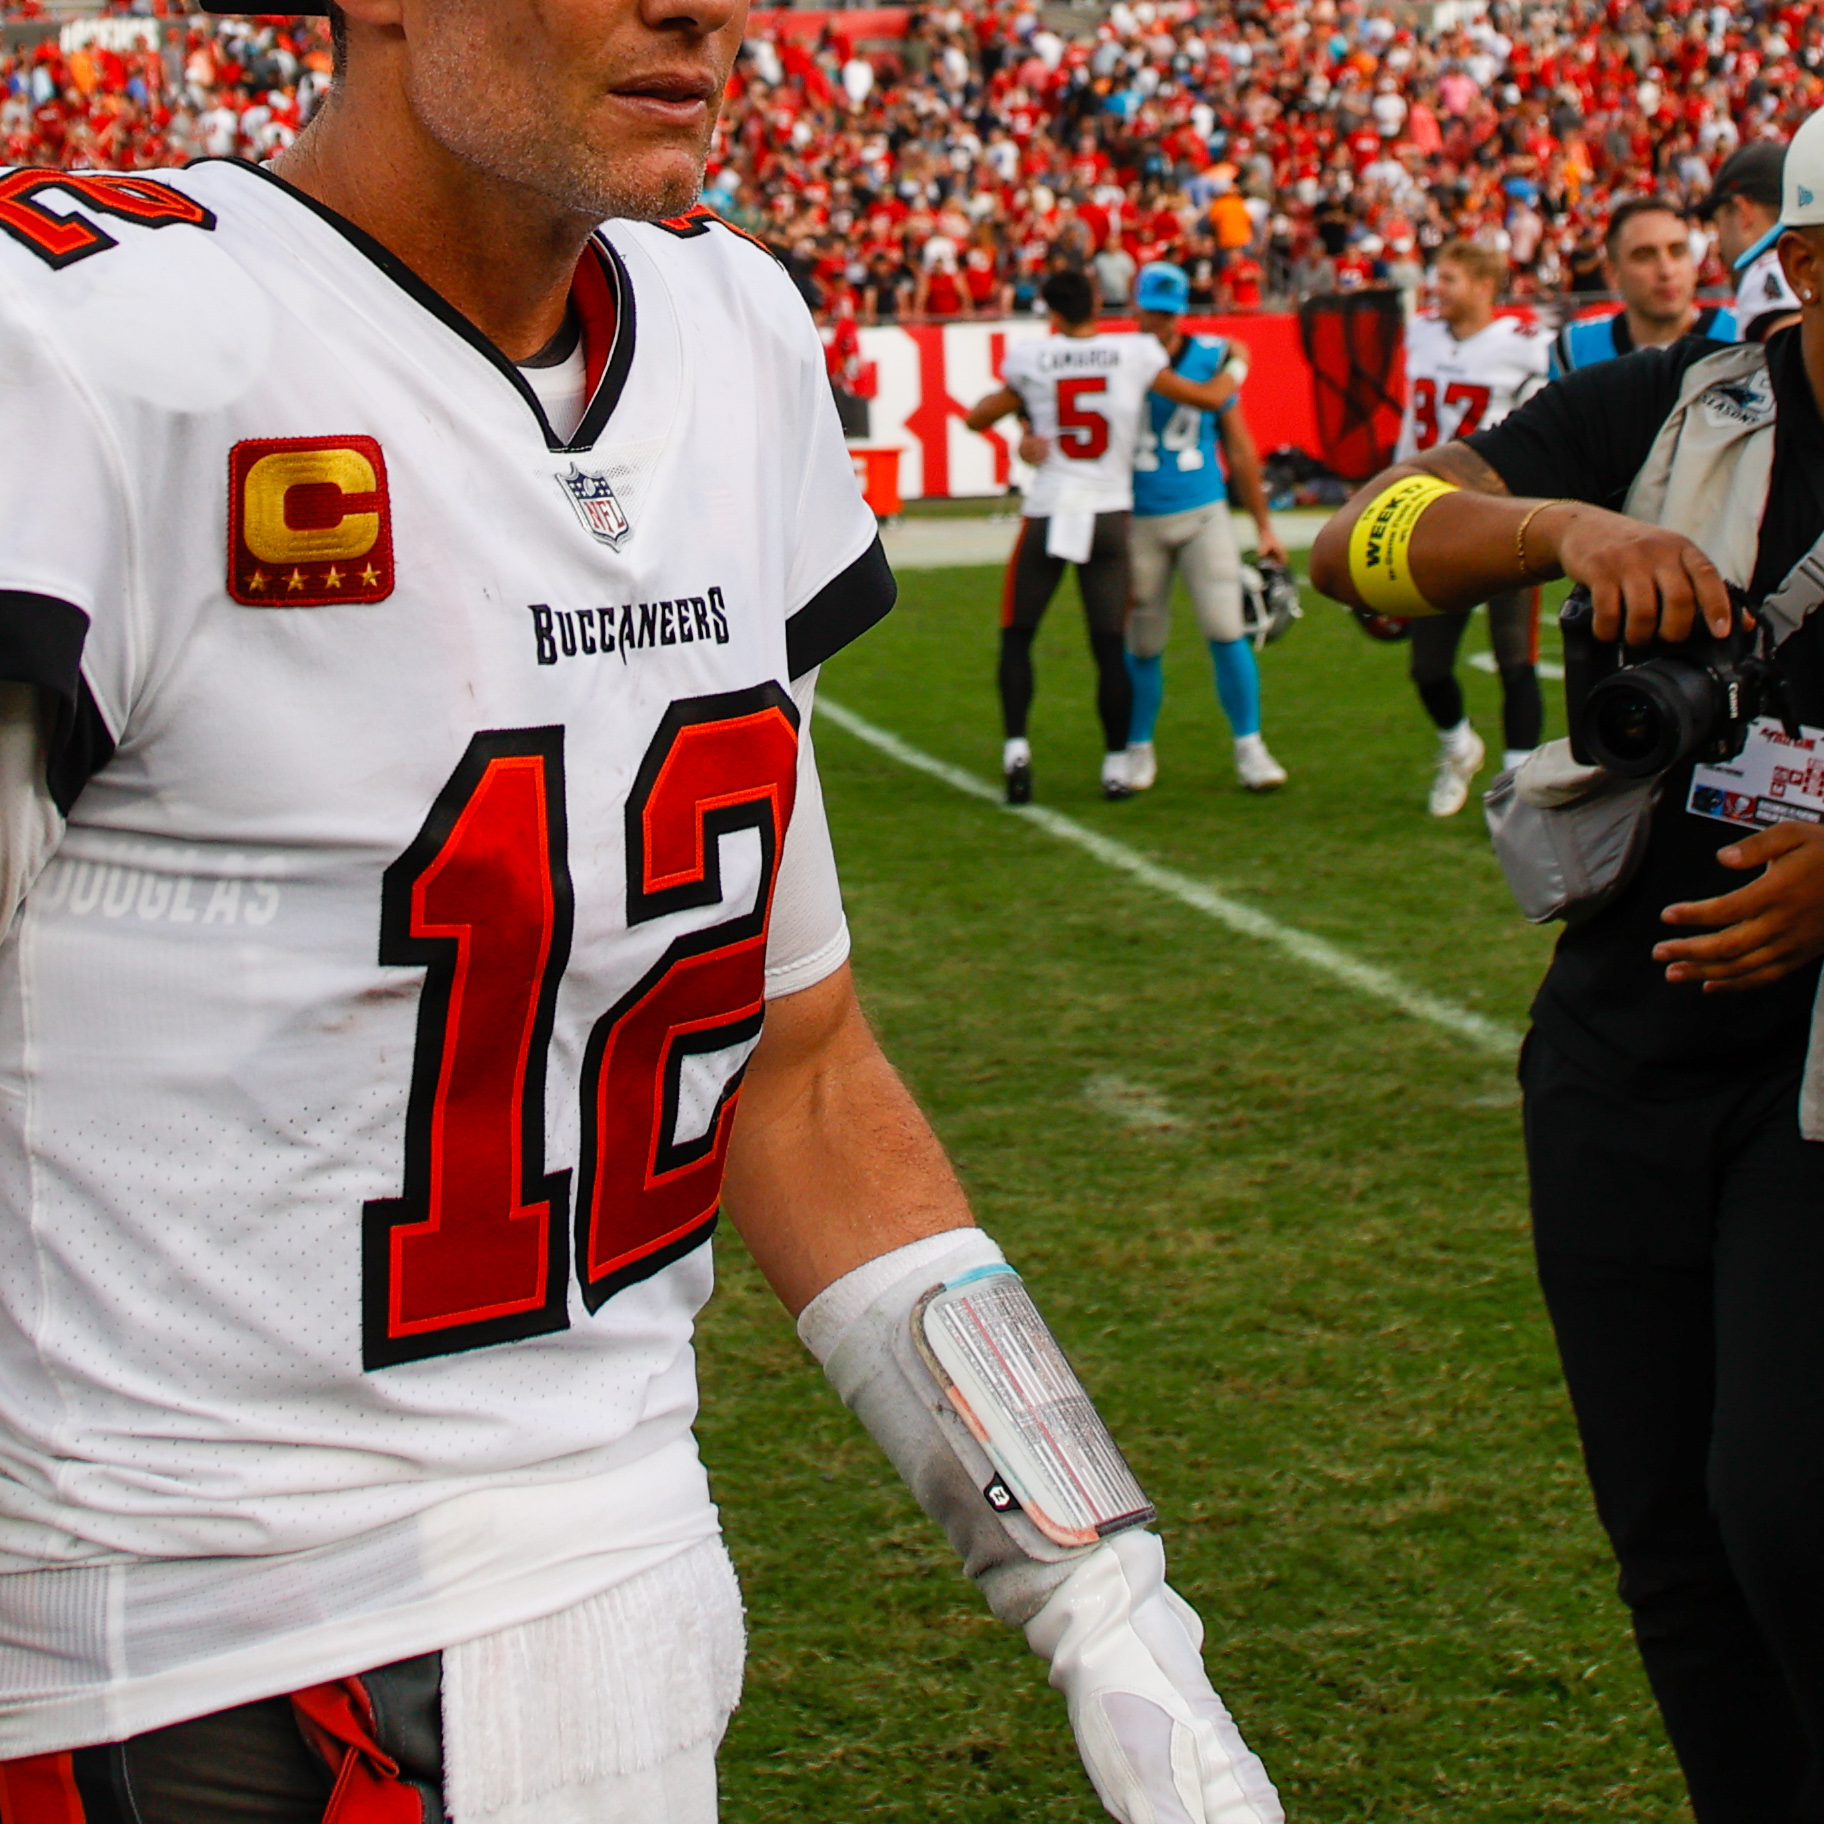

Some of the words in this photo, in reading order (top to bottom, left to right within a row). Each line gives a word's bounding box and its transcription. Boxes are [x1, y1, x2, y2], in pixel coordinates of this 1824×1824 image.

[1057, 378, 1109, 459] 5
[244, 448, 380, 564] C
[583, 496, 625, 530] NFL
[1366, 497, 1404, 568] WEEK
[1729, 682, 1739, 719] Canon
[34, 844, 282, 926] DOUGLAS
[362, 680, 800, 1371] 12
